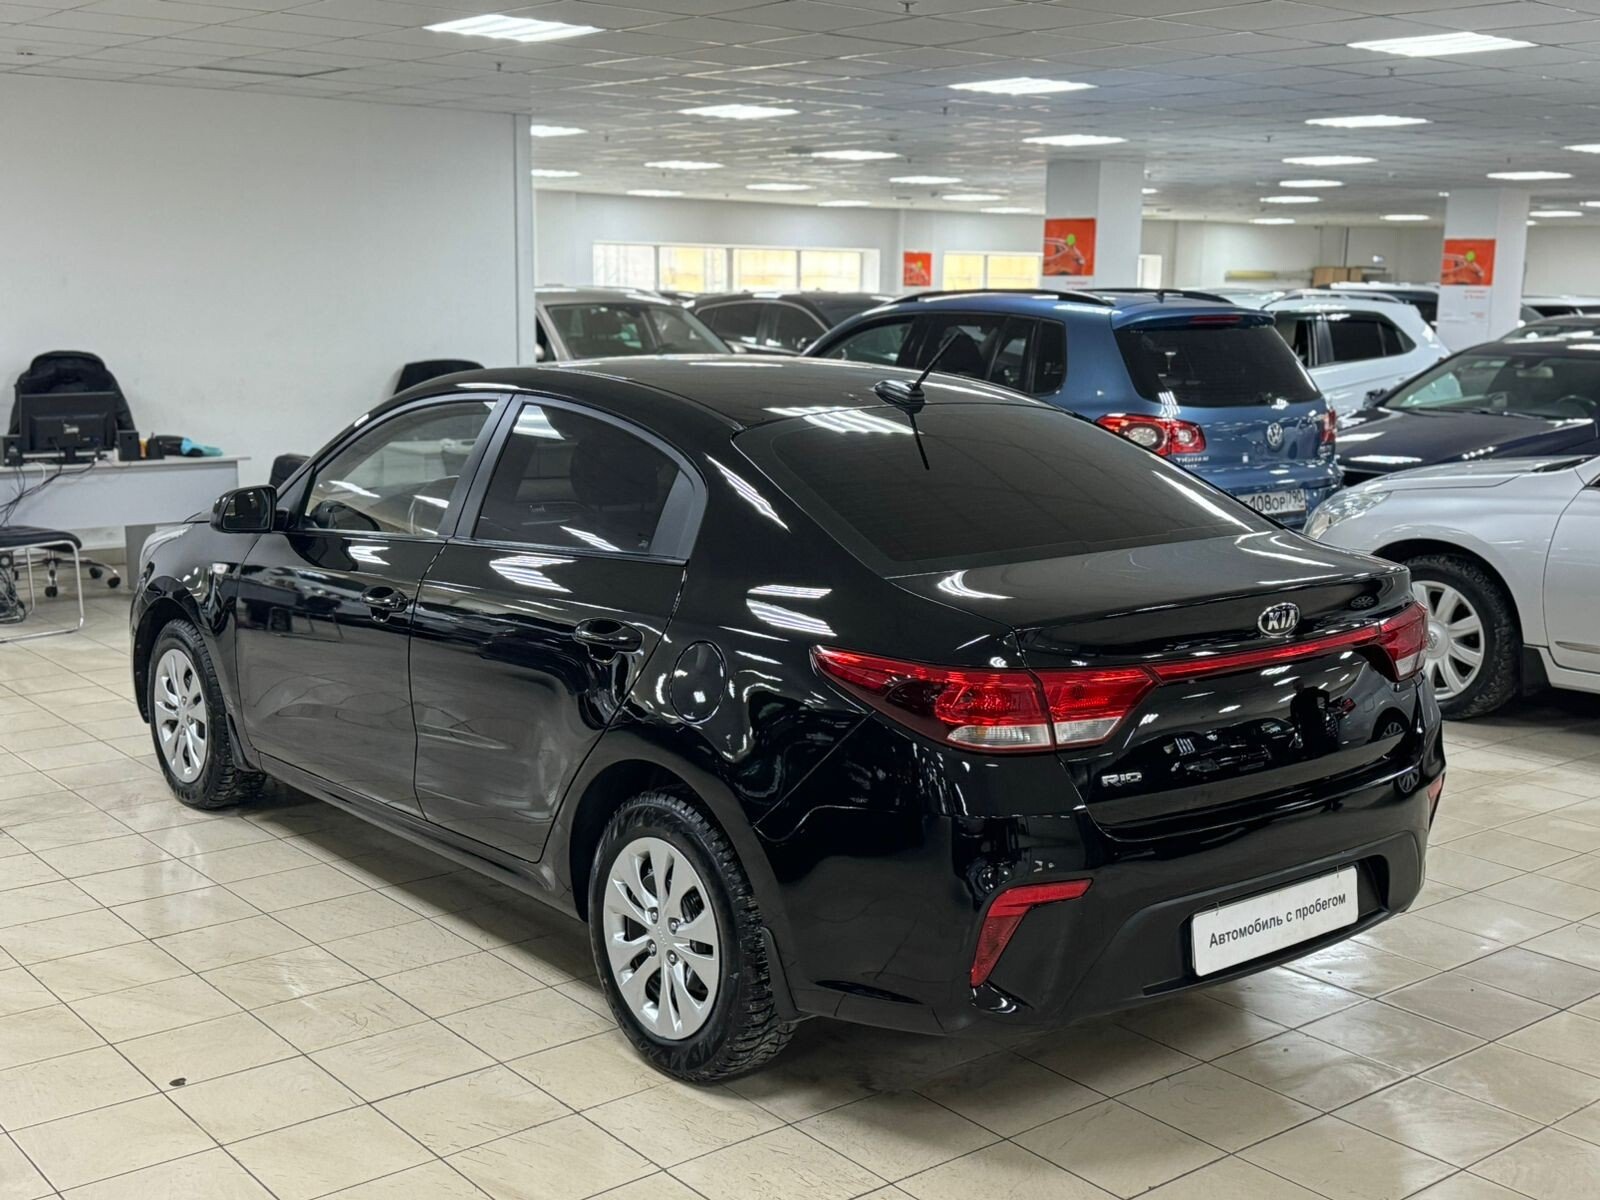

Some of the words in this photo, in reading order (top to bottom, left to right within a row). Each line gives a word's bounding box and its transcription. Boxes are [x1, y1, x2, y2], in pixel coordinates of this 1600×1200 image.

[1267, 609, 1296, 631] KIA
[1101, 771, 1142, 788] RIO
[1209, 917, 1283, 948] Автомобиль
[1286, 911, 1293, 923] с
[1295, 893, 1346, 921] пробегом
